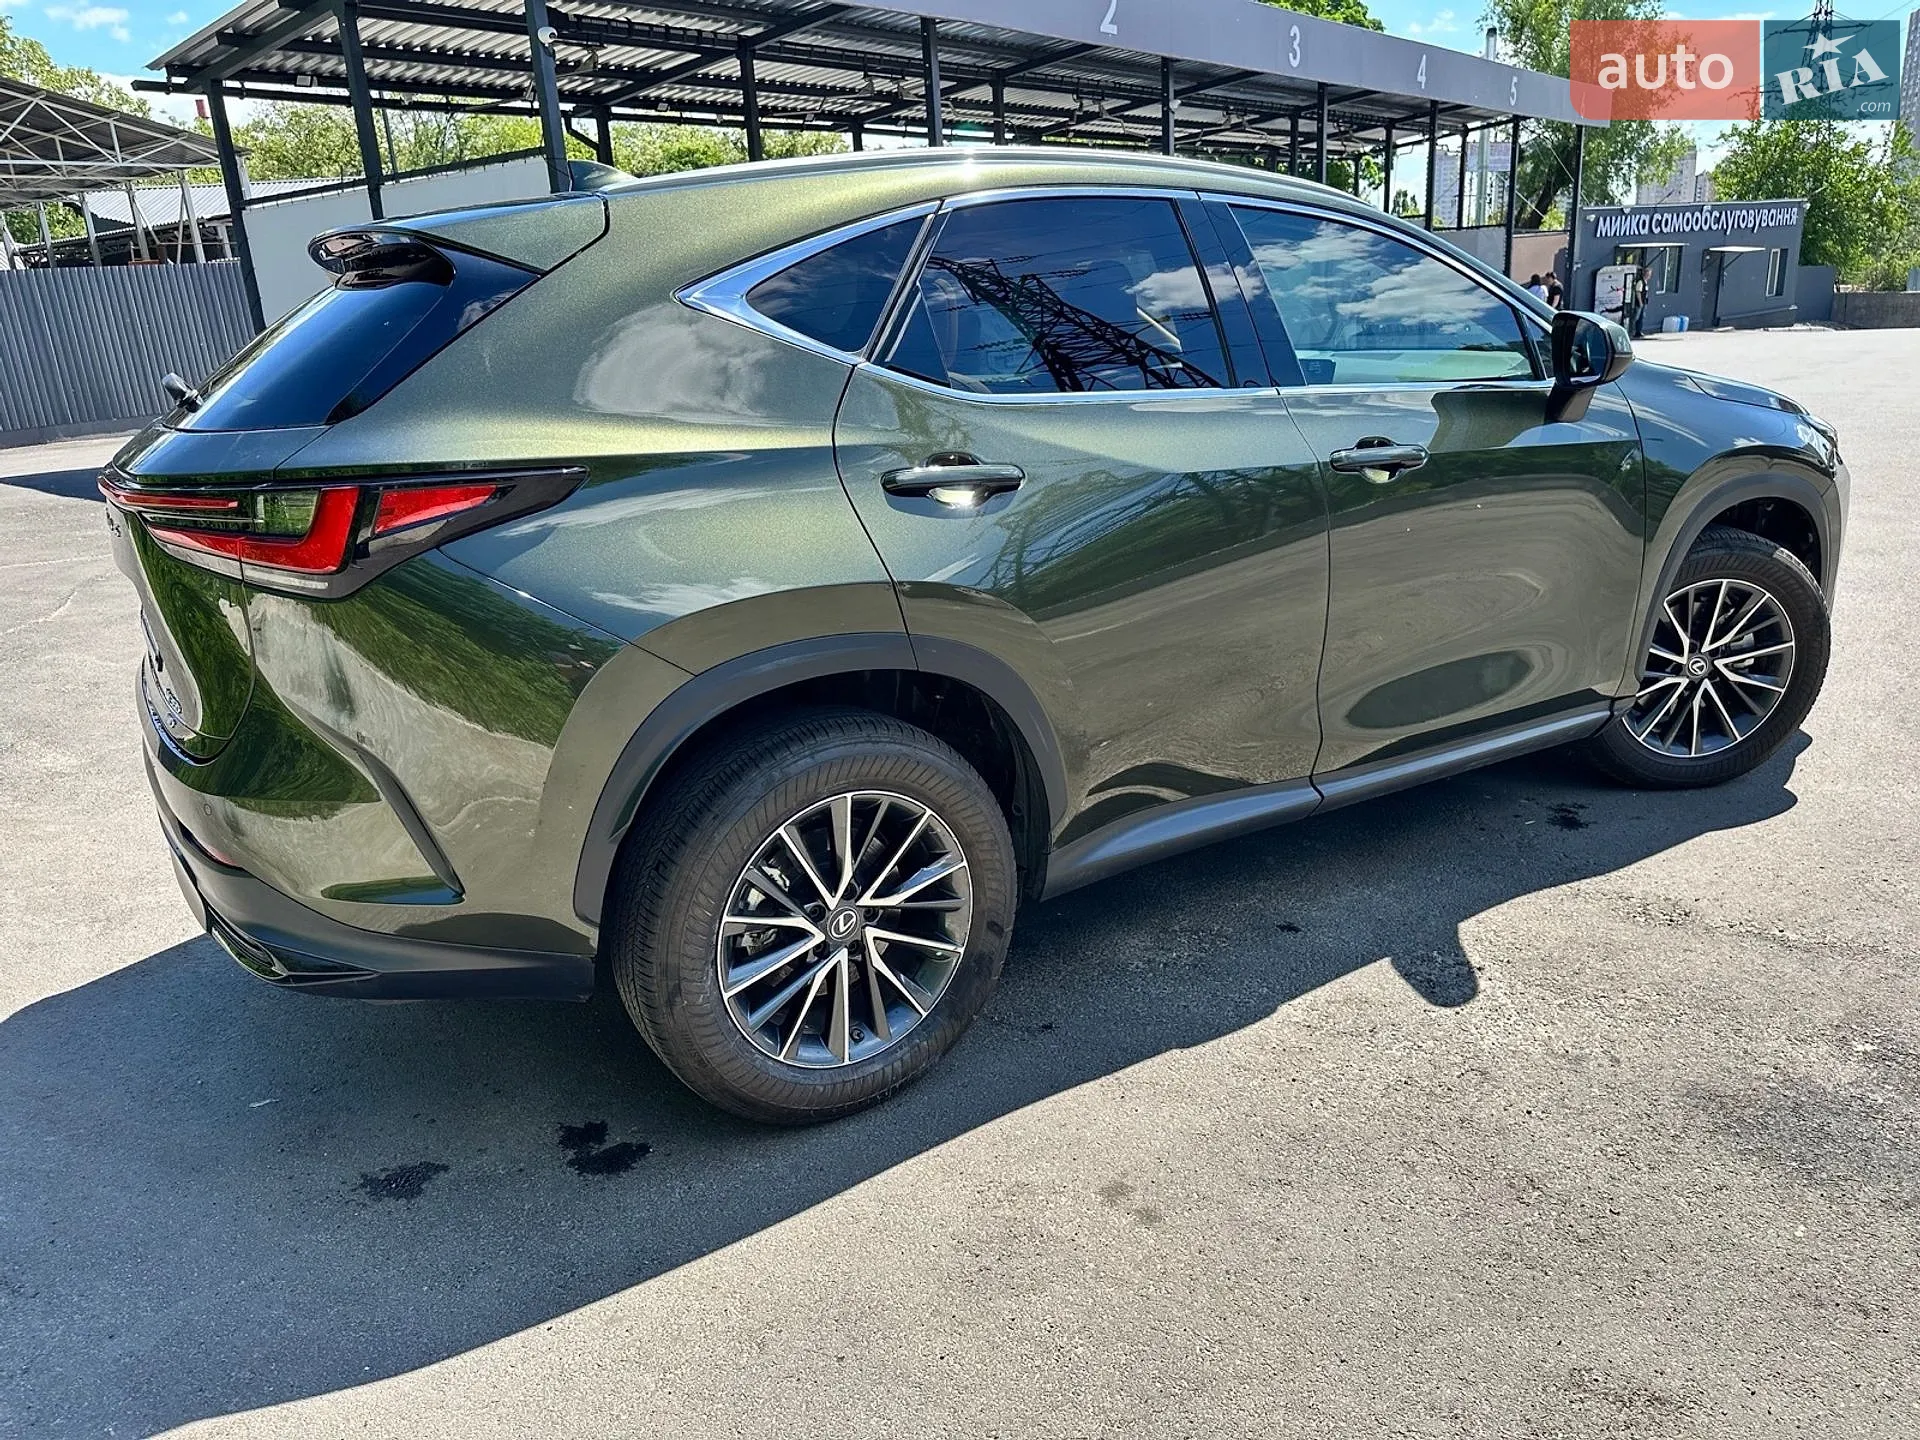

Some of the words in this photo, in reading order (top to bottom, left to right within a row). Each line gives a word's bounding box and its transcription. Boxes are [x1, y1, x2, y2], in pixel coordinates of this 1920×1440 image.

[1100, 0, 1117, 35] 2
[1288, 24, 1301, 68] 3
[1416, 53, 1427, 90] 4
[1509, 75, 1518, 106] 5
[1652, 205, 1798, 236] самообслуговування
